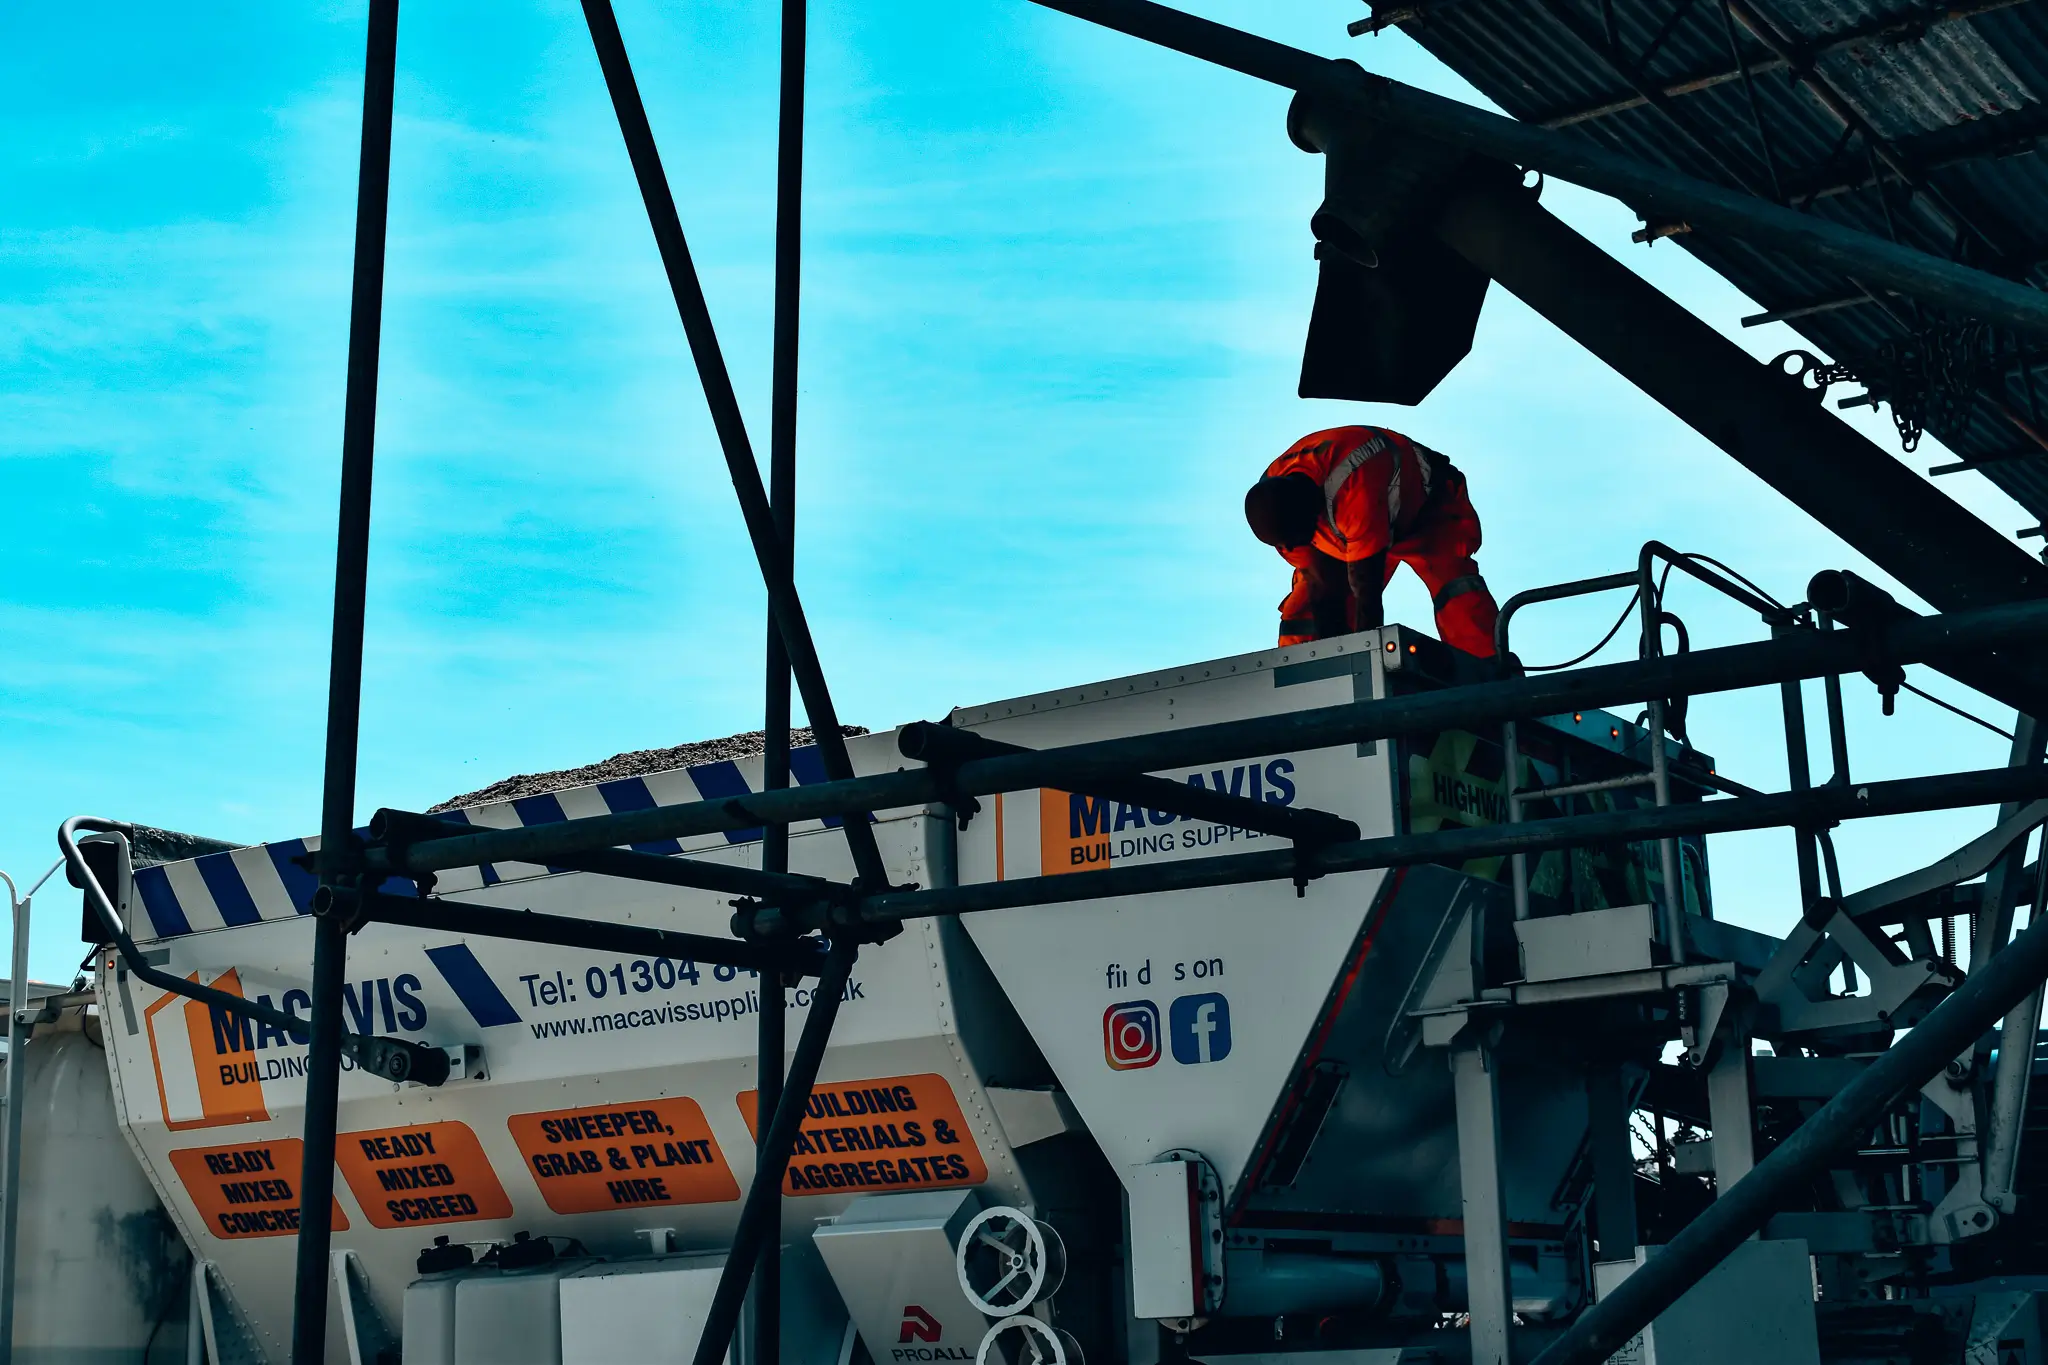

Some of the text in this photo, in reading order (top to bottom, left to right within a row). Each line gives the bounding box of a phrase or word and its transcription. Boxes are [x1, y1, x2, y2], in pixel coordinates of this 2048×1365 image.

[1432, 771, 1511, 825] HIGHWA
[1071, 824, 1270, 866] BUILDING SUPPL
[519, 971, 577, 1007] Tel:
[586, 957, 701, 999] 01304
[209, 974, 427, 1055] MACVIS
[220, 1056, 310, 1086] BUILDIN
[801, 1086, 917, 1120] UILDING
[541, 1110, 675, 1144] SWEEPER,
[933, 1119, 960, 1145] &
[359, 1132, 436, 1161] READY
[532, 1140, 714, 1178] GRAB & PLANT
[204, 1149, 276, 1175] READY
[788, 1154, 969, 1190] AGGREGATES
[220, 1179, 294, 1204] MIXED
[376, 1163, 456, 1192] MIXED
[606, 1178, 672, 1204] HIRE
[218, 1208, 302, 1234] CONCRE
[386, 1193, 479, 1222] SCREED
[891, 1347, 975, 1362] PROALL
